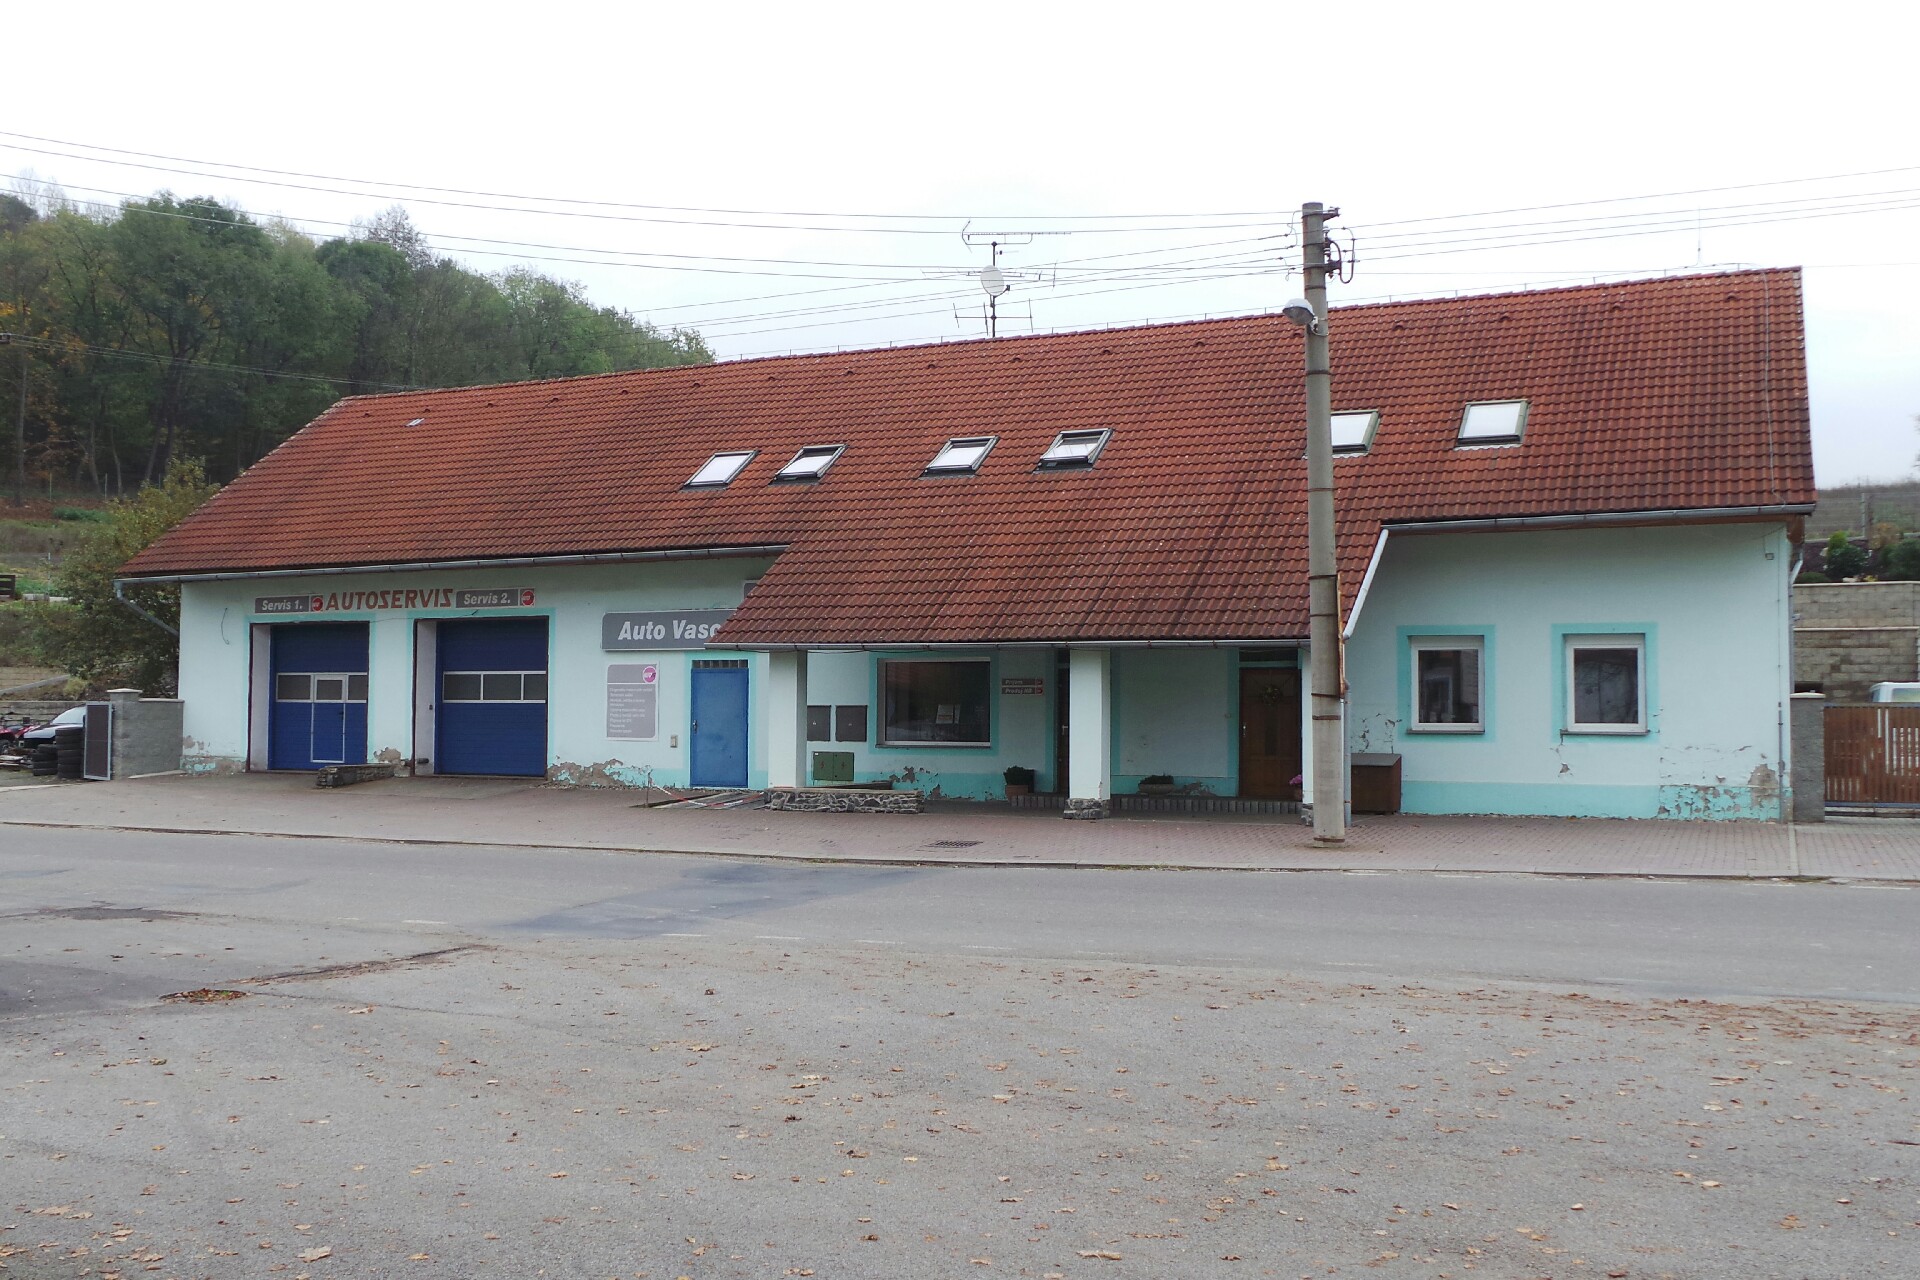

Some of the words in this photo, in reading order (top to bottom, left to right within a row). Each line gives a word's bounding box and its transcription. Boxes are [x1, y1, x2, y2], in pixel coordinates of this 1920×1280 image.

[262, 600, 291, 611] Servis
[294, 599, 303, 609] 1.
[326, 588, 454, 611] AUTOSERVIS
[463, 593, 498, 605] Servis
[501, 592, 511, 604] 2.
[618, 621, 666, 640] Auto
